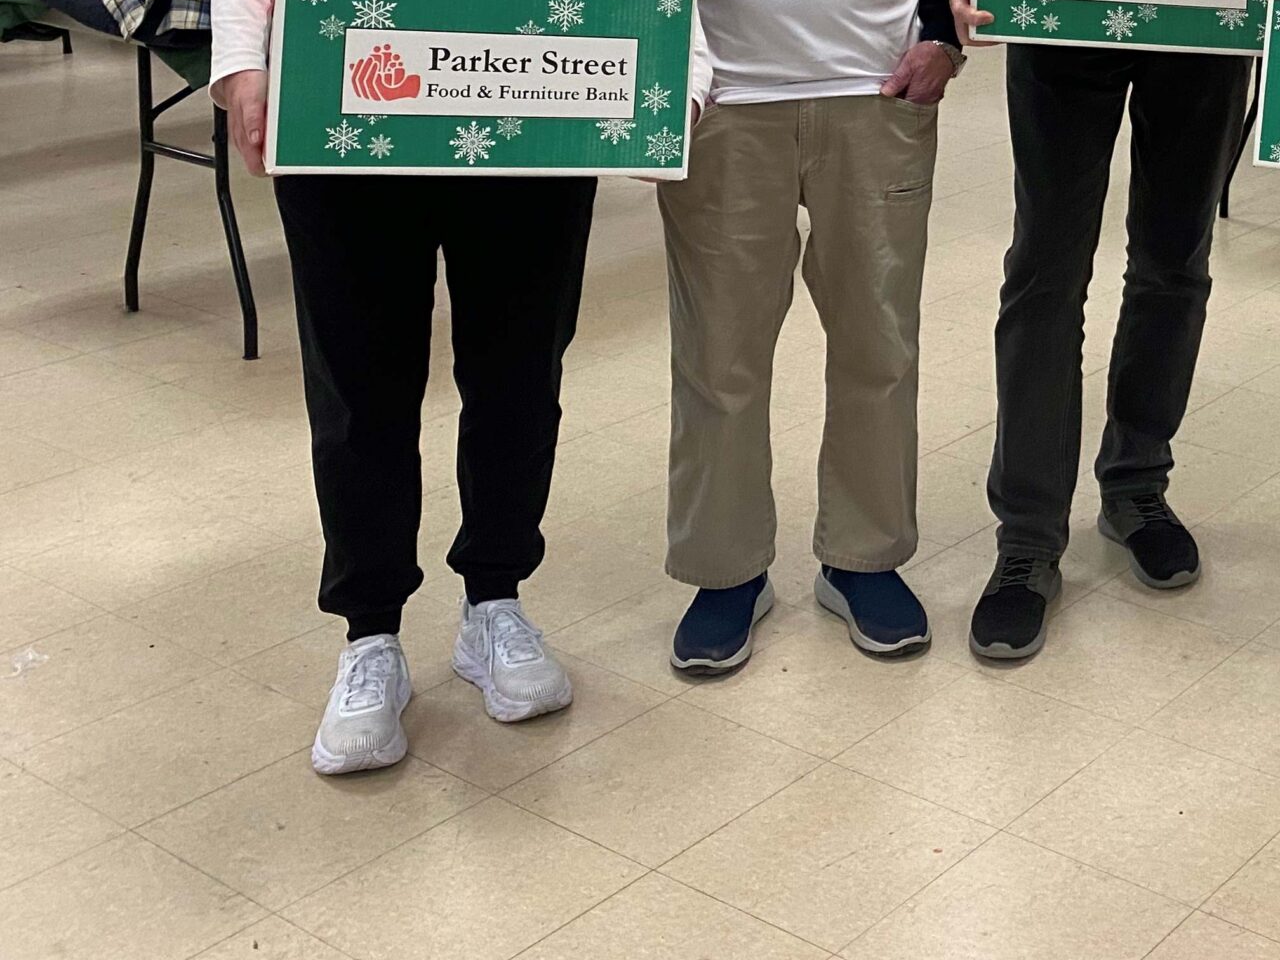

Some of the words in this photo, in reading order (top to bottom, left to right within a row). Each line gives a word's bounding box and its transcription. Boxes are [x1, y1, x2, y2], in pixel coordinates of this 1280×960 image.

[428, 46, 532, 74] Parker
[541, 50, 629, 76] Street
[425, 83, 471, 99] Food
[477, 85, 492, 99] &
[499, 85, 580, 101] Furniture
[585, 87, 630, 102] Bank
